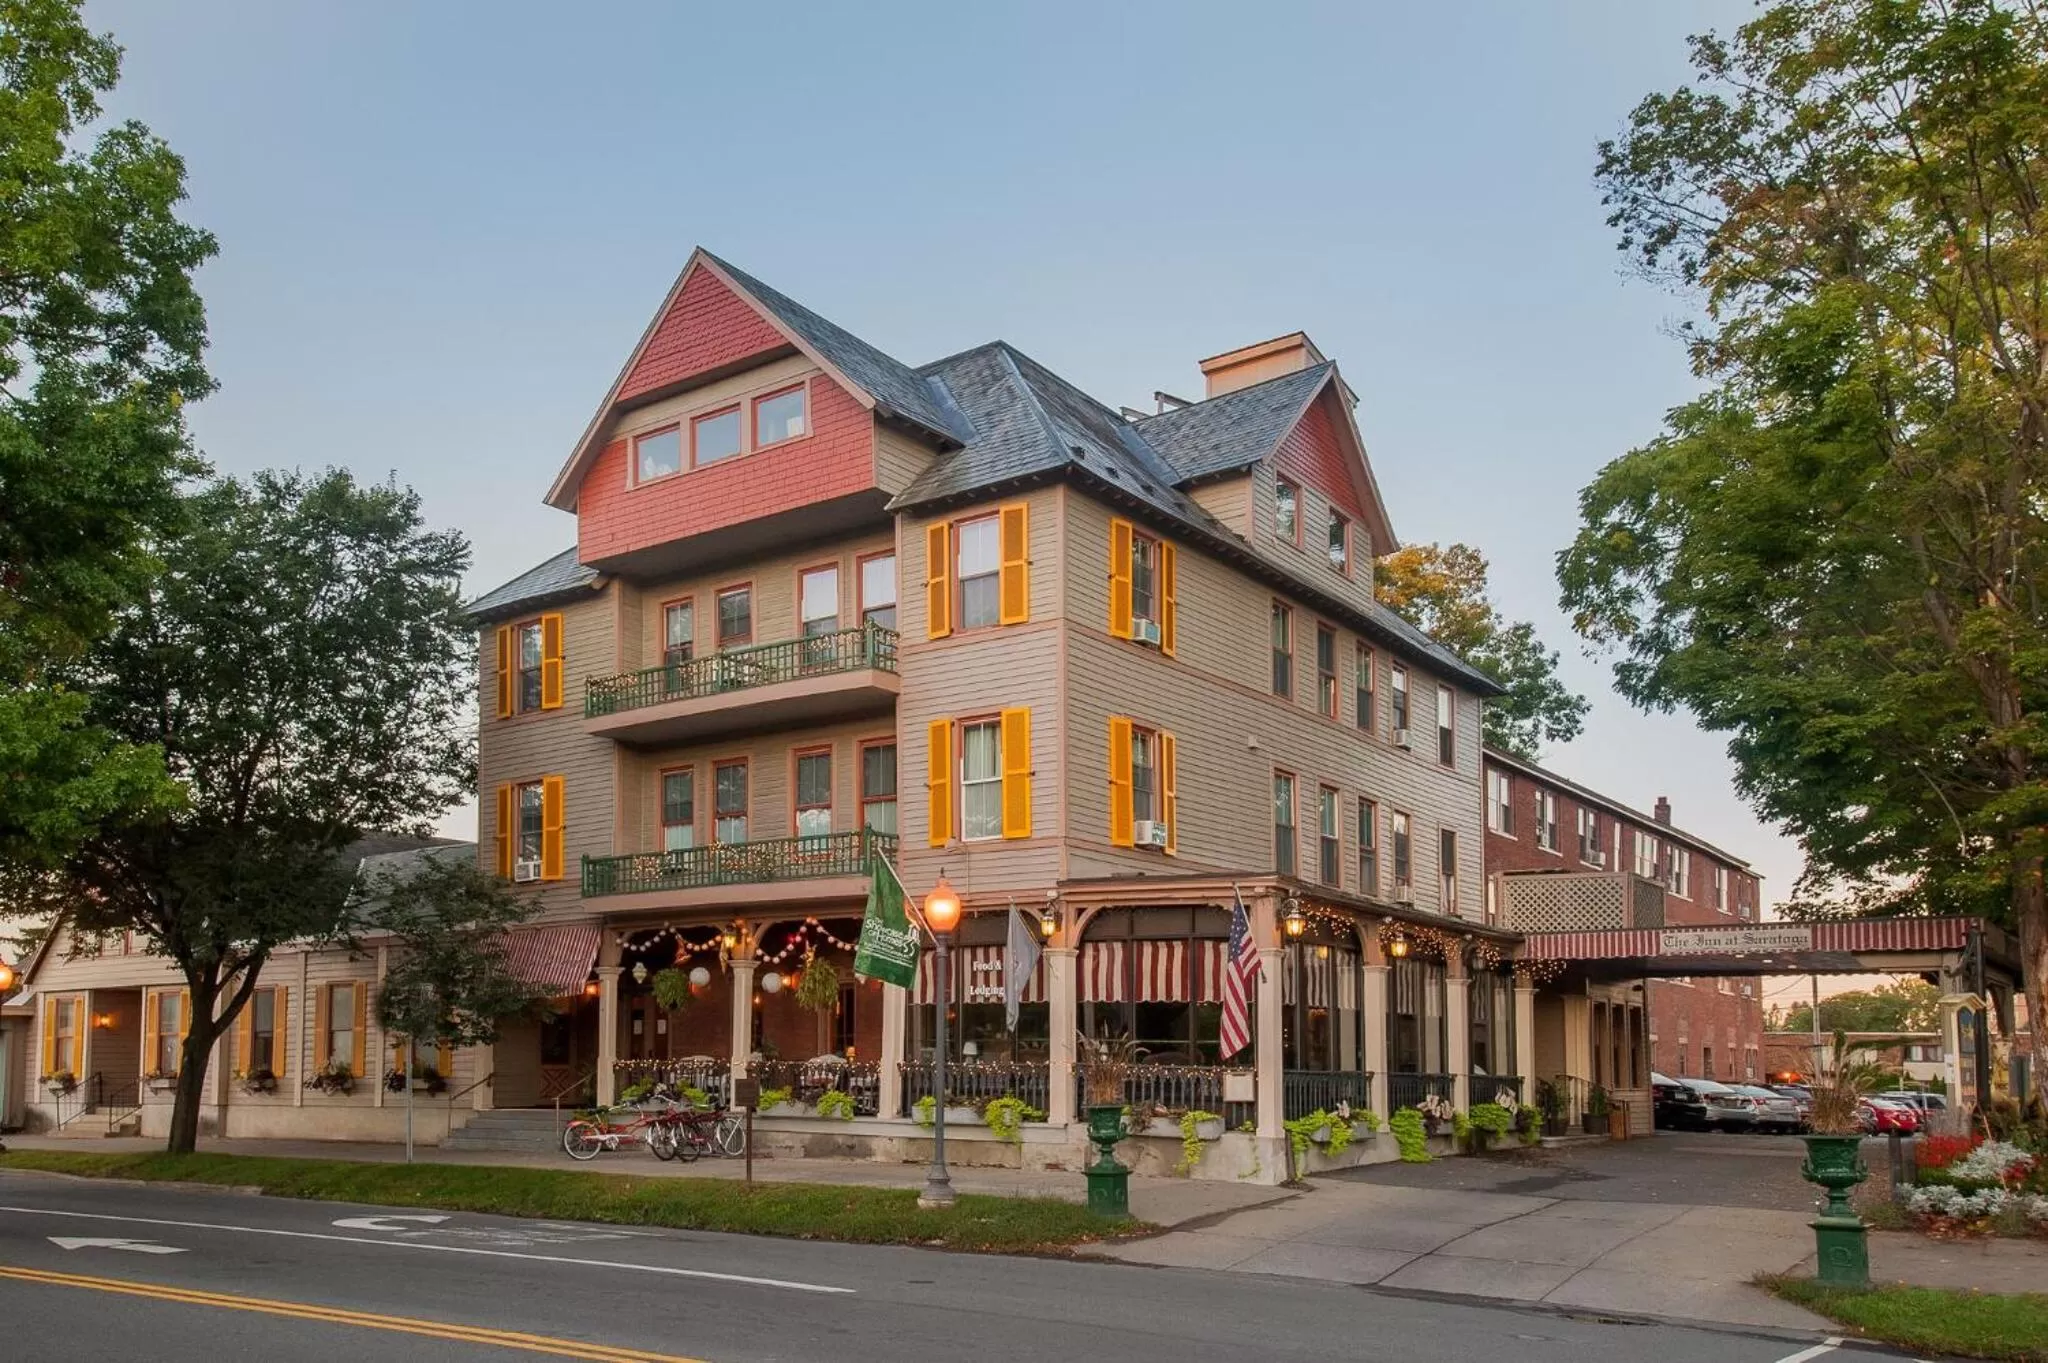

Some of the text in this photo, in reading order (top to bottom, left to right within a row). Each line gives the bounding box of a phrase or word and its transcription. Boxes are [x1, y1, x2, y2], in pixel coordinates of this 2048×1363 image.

[1663, 932, 1809, 948] The Inn at Saratoga
[973, 960, 994, 972] Food
[969, 984, 1005, 998] Lodging
